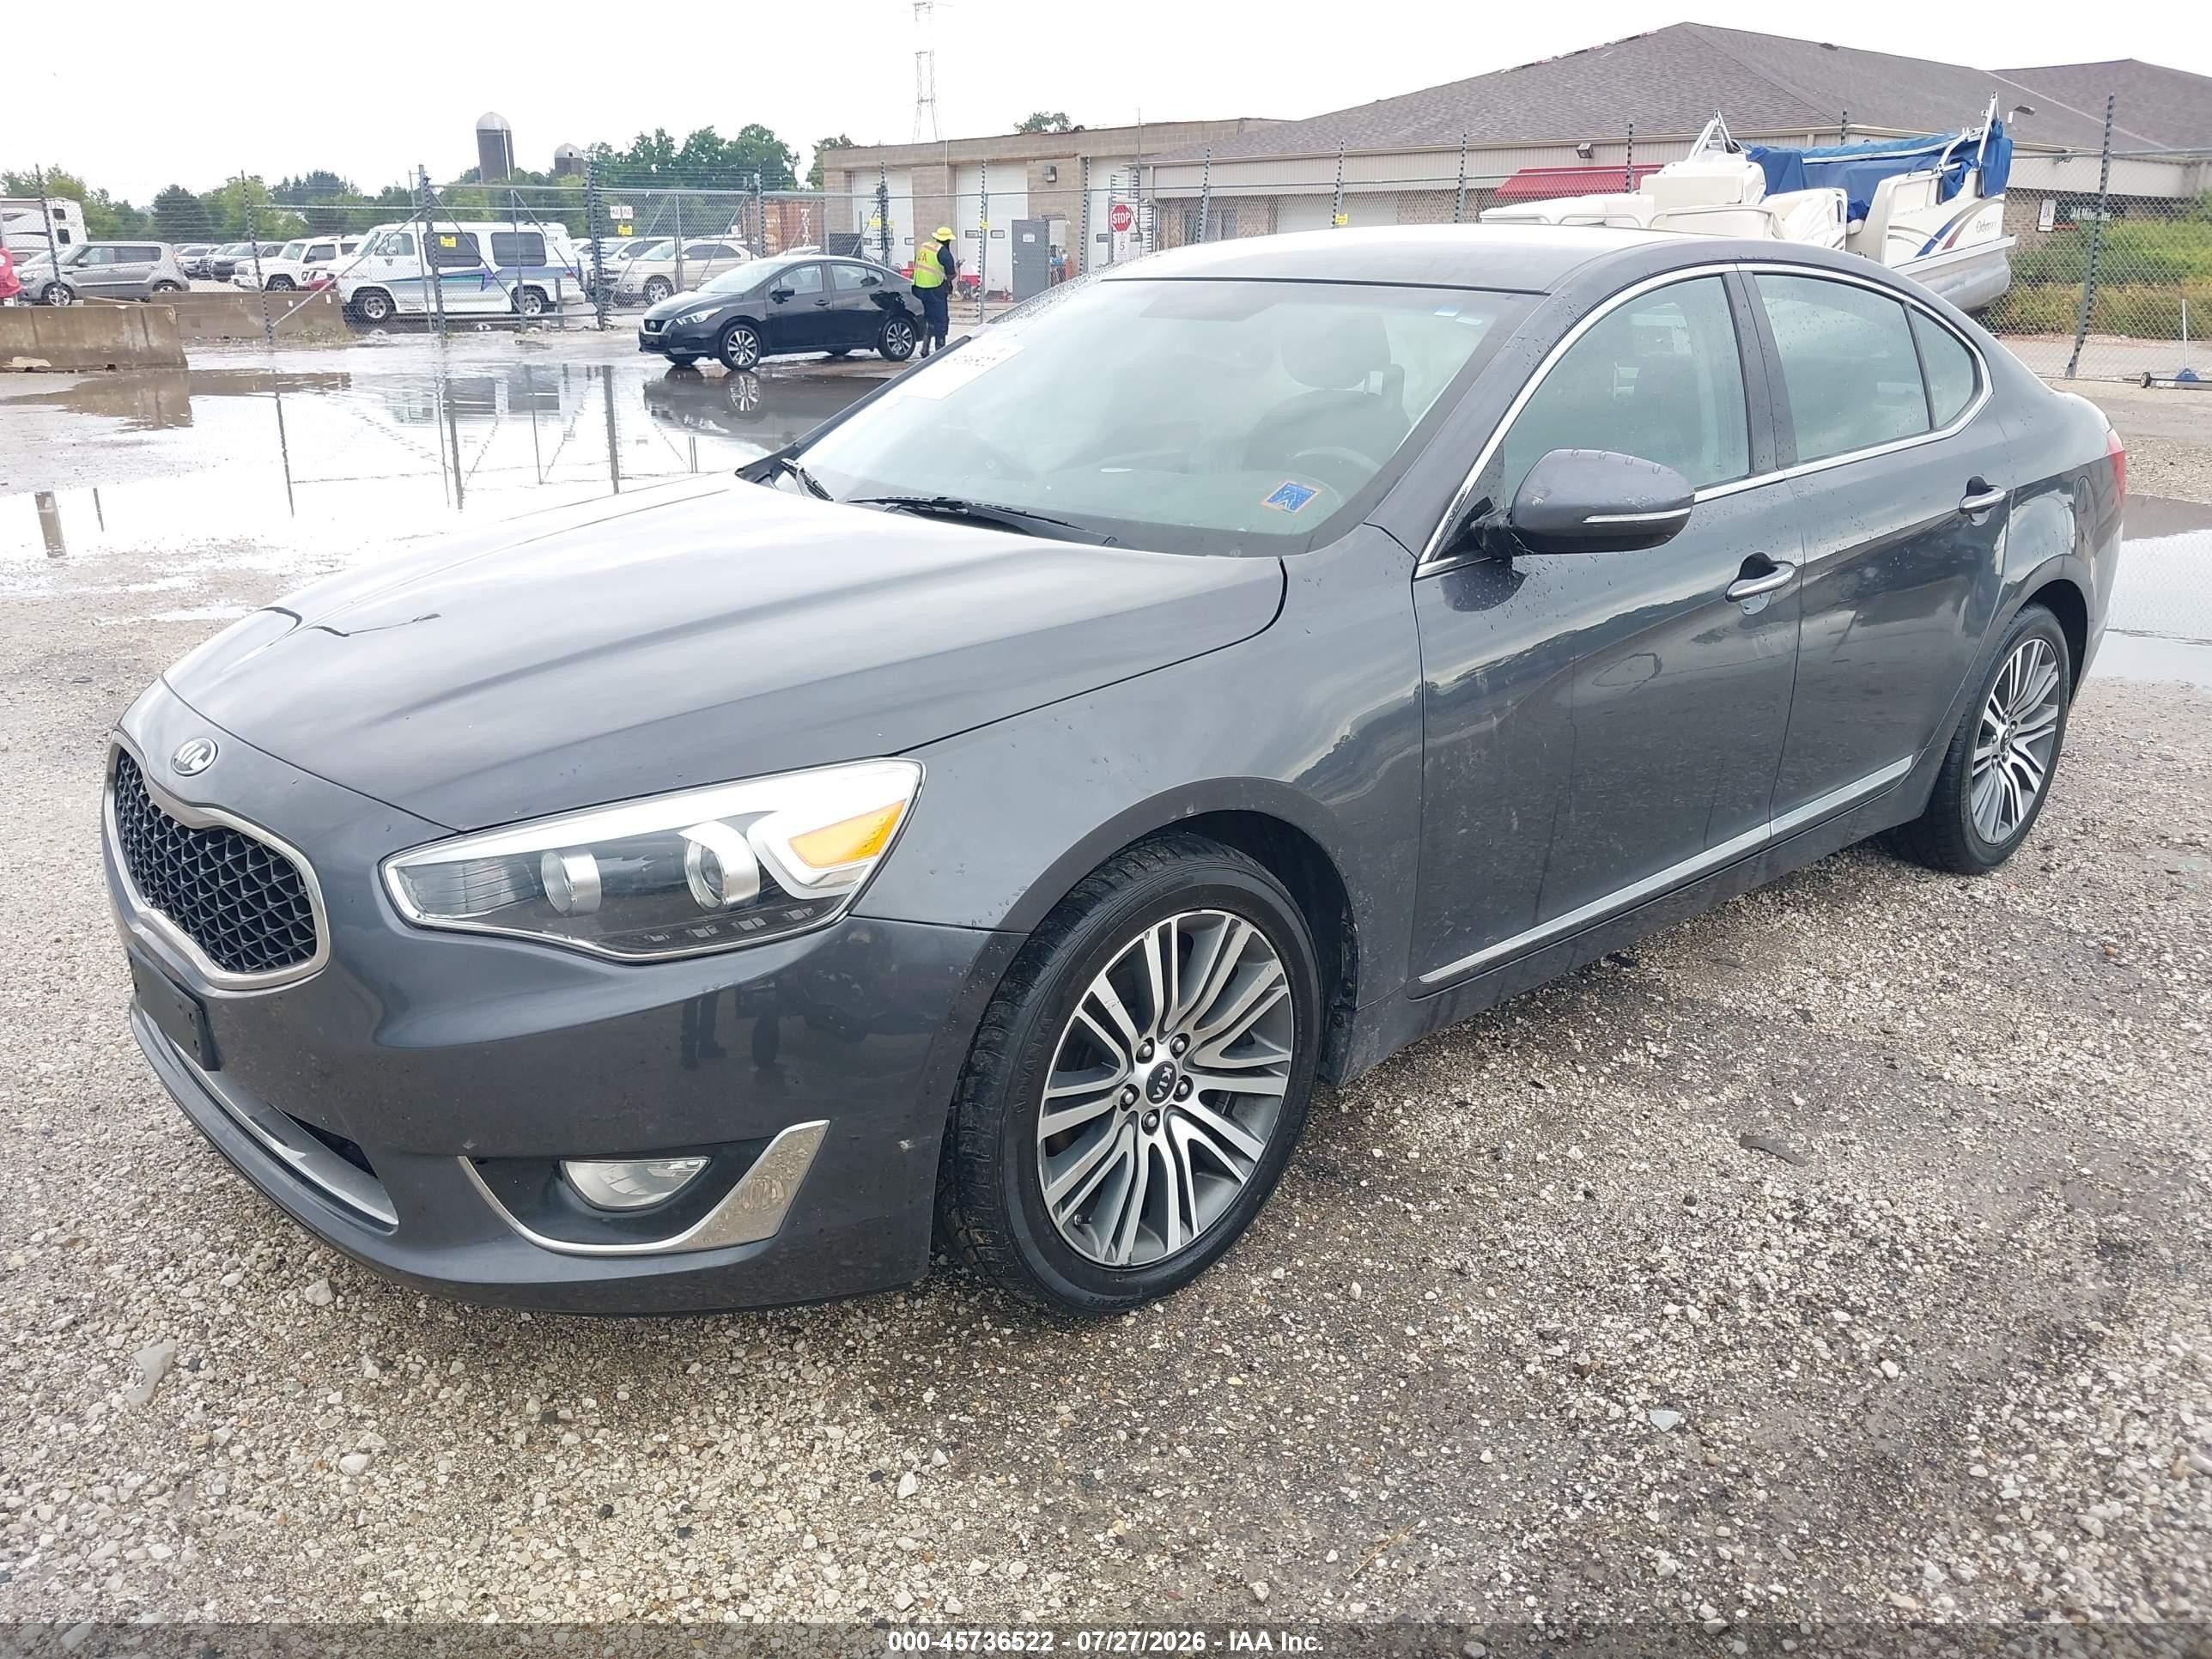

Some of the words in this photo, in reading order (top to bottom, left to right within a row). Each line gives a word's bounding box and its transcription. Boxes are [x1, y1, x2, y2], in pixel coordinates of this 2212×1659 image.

[1112, 212, 1131, 224] STOP
[1119, 240, 1126, 251] 5
[176, 740, 208, 770] KIA
[1152, 1066, 1173, 1099] KIA
